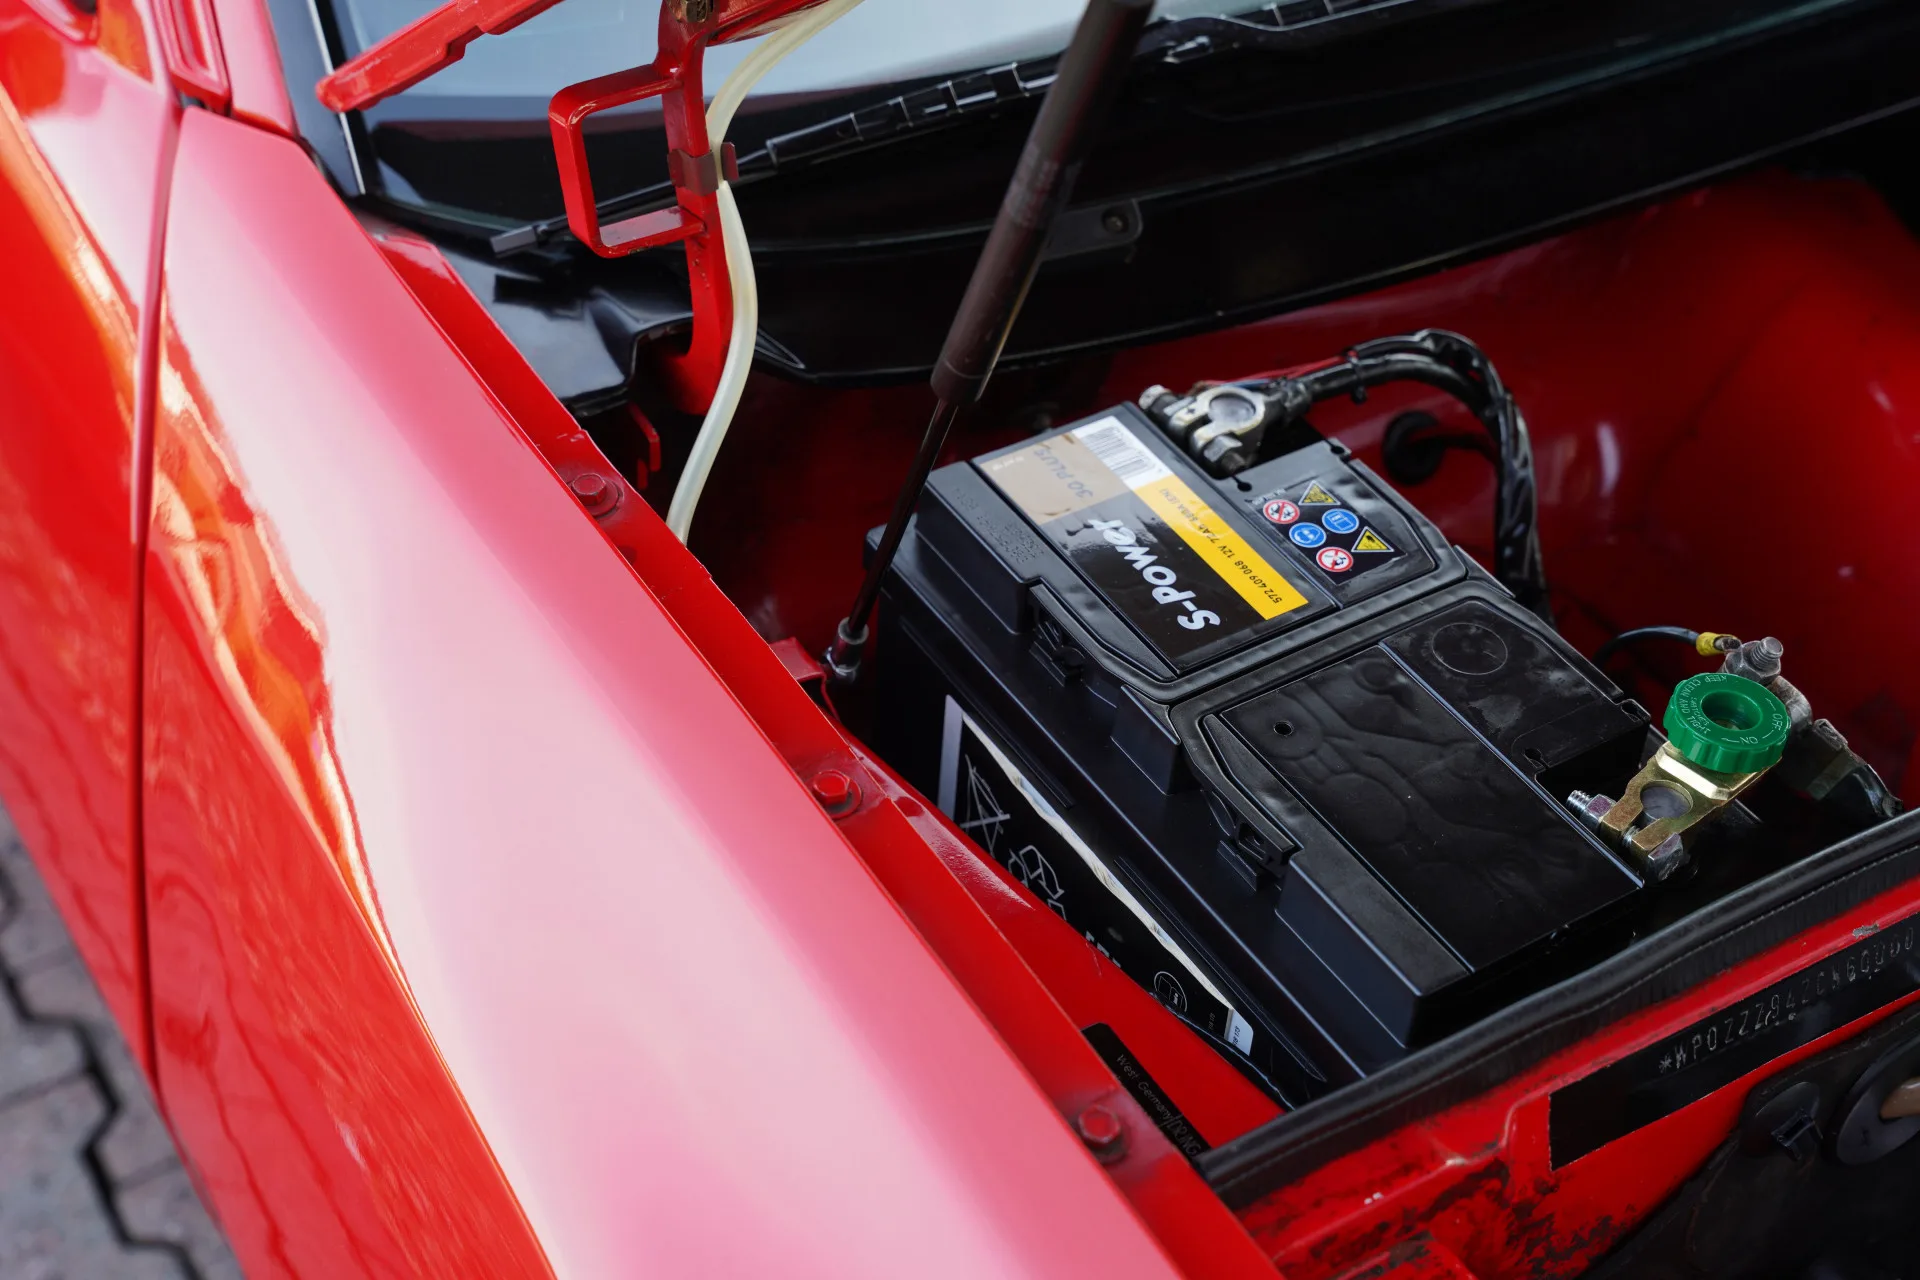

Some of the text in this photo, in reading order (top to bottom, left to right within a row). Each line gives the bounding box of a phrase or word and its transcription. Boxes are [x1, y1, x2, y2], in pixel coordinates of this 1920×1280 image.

[1217, 544, 1236, 559] 12V
[1087, 518, 1221, 631] S-Power
[1234, 560, 1253, 575] 068
[1249, 575, 1267, 589] 409
[1263, 588, 1283, 604] 572
[1679, 674, 1727, 735] KEEP CLEAN AND TIGHT
[1739, 712, 1784, 746] OFF ON
[1116, 1053, 1140, 1080] West
[1138, 1081, 1175, 1123] Germany
